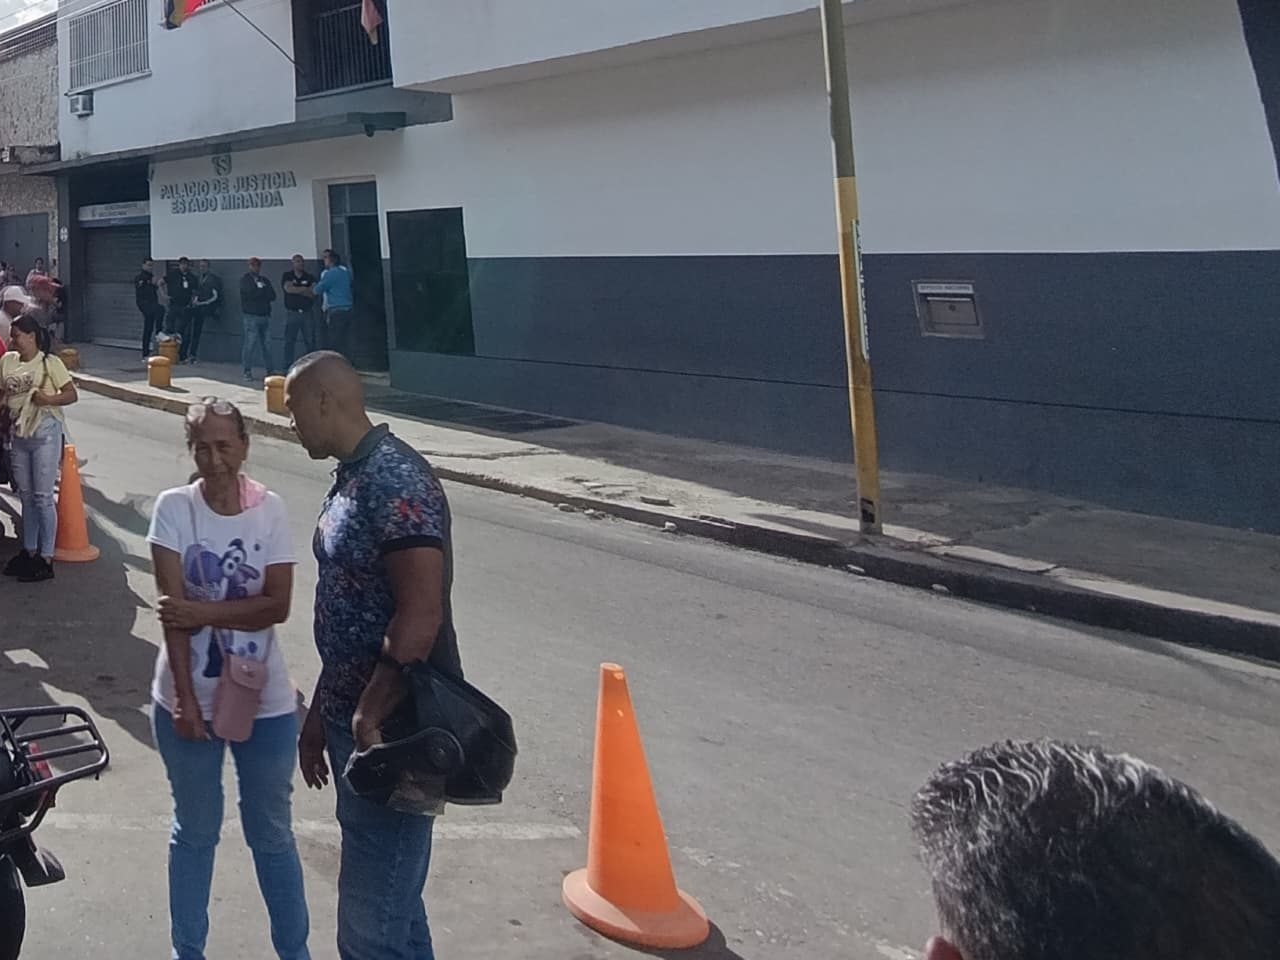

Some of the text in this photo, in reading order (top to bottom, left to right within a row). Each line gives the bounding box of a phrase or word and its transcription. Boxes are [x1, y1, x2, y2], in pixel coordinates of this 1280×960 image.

[160, 170, 297, 200] PALACIO DE JUSTICIA
[171, 191, 284, 214] ESTADO MIRANDA
